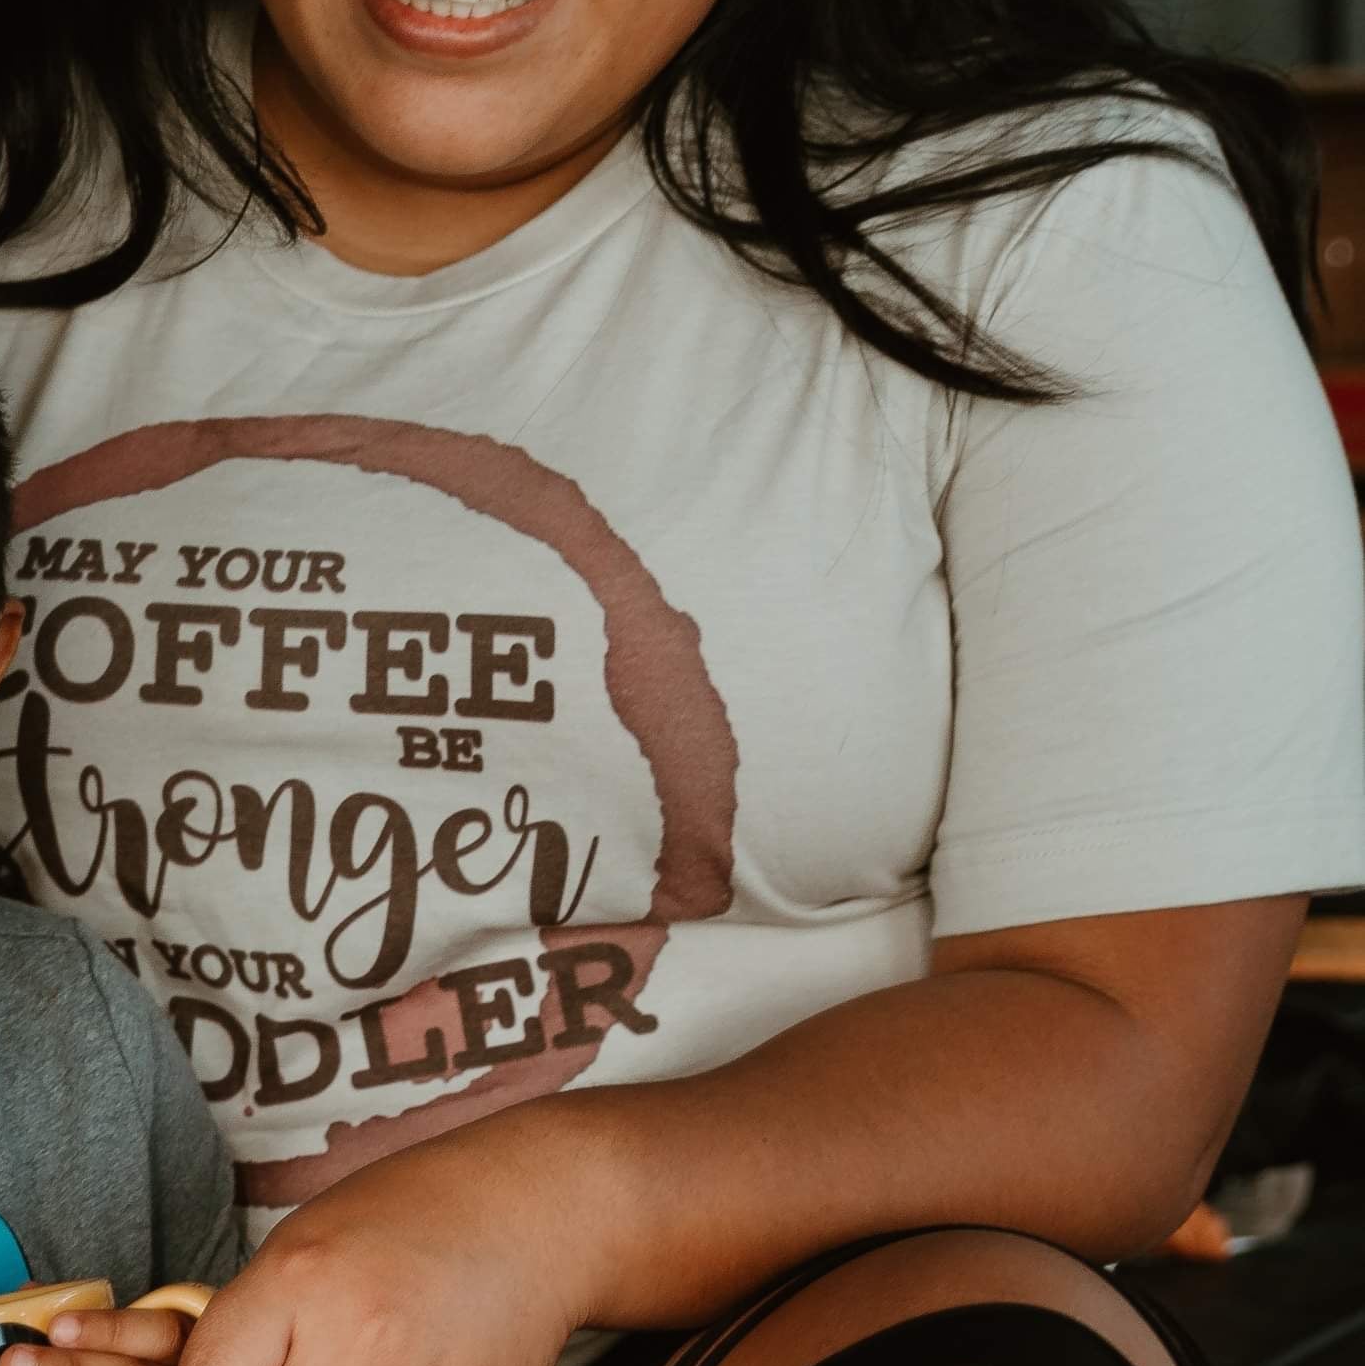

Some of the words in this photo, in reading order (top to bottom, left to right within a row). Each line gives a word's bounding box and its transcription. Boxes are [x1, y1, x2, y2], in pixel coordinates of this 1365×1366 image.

[16, 536, 158, 585] MAY
[176, 545, 346, 594] YOUR
[397, 726, 484, 773] BE
[151, 938, 313, 999] YOUR
[169, 941, 658, 1107] DDLER
